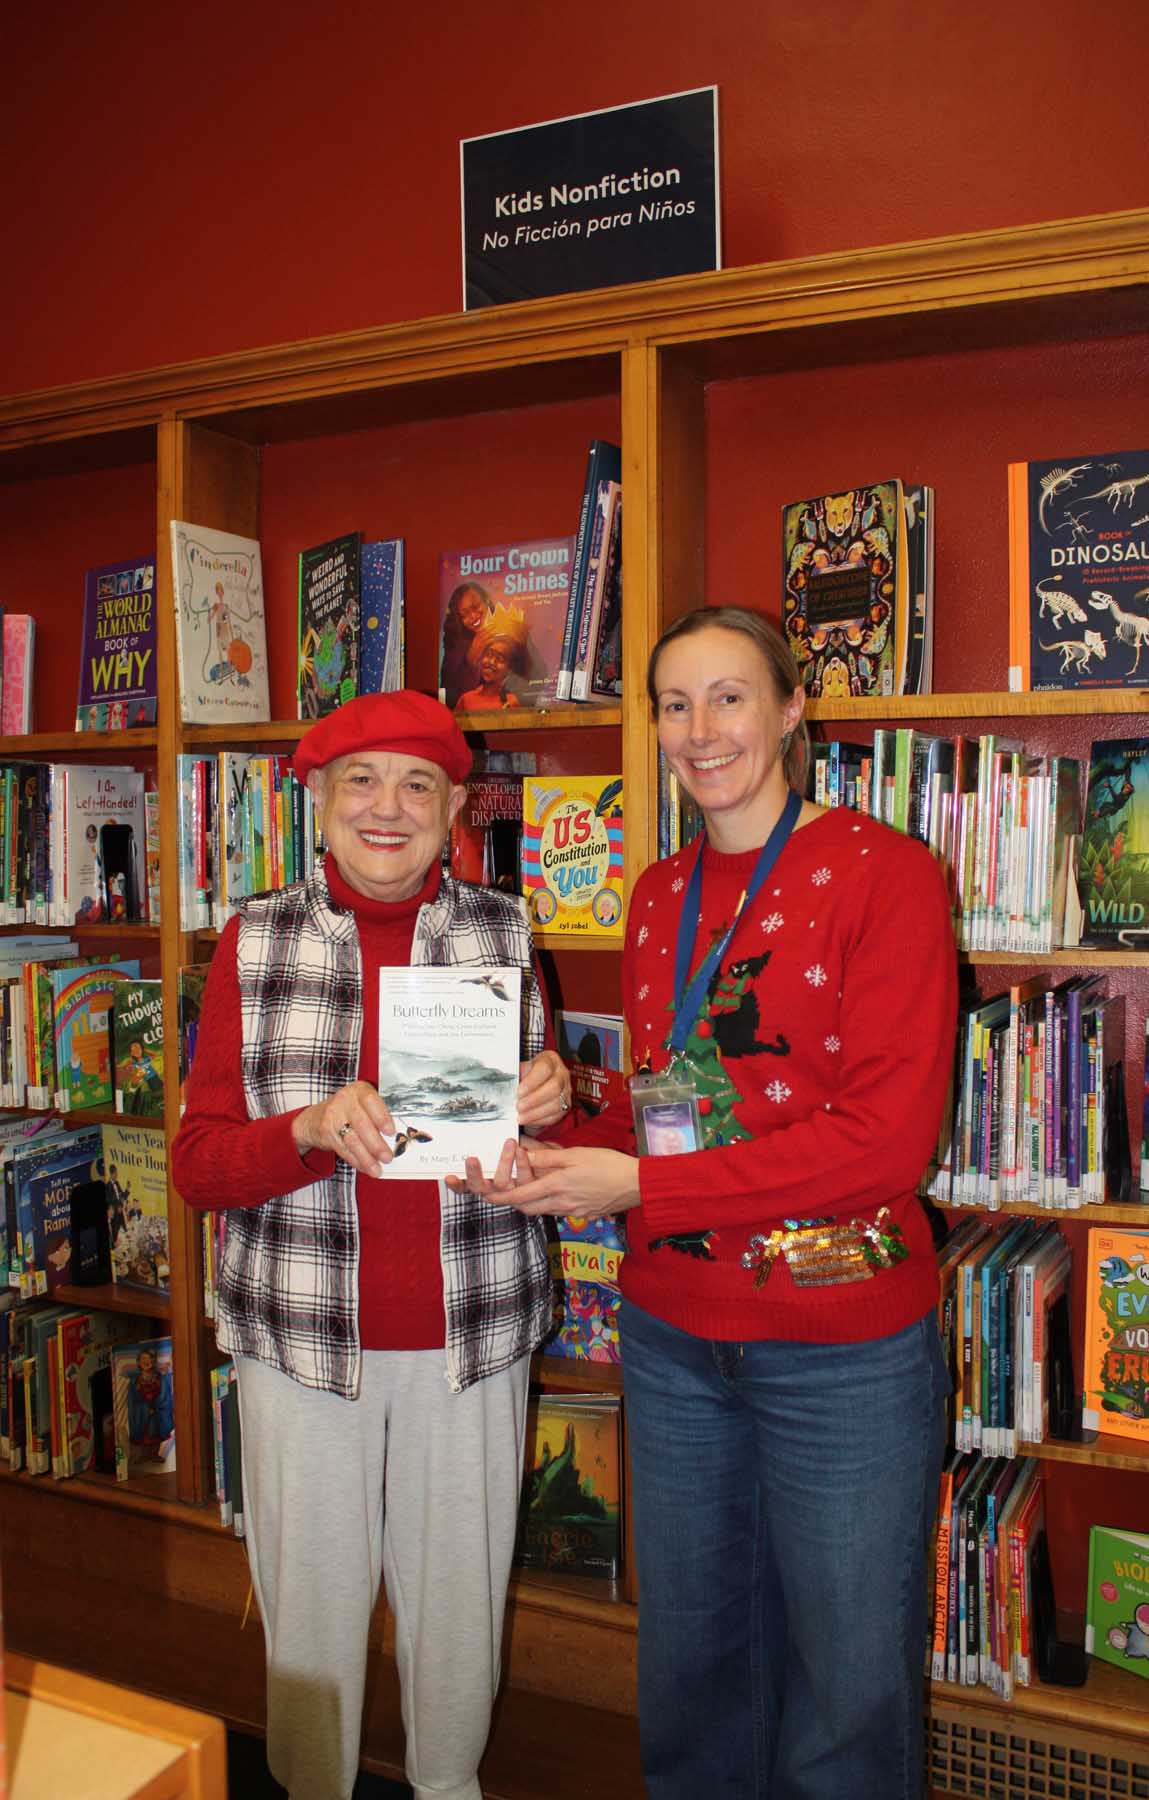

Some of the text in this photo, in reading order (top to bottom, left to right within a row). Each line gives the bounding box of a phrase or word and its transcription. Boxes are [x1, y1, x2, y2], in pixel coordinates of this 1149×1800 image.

[495, 167, 680, 217] Kids Nonfiction
[483, 200, 695, 250] No Ficción para Niños
[189, 548, 247, 576] Cinderella
[460, 547, 569, 576] Your Crown
[1050, 541, 1149, 567] DINOSAU
[311, 558, 333, 583] WEIRD
[334, 553, 345, 569] AND
[308, 564, 348, 601] WONDERFUL
[504, 572, 568, 595] Shines
[104, 593, 152, 619] WORLD
[323, 594, 343, 615] PLANET
[95, 612, 152, 639] ALMANAC
[104, 636, 139, 652] BOOK OF
[91, 649, 153, 693] WHY
[76, 795, 137, 809] Left-Handed!
[566, 804, 579, 815] The
[553, 809, 595, 849] U.S.
[543, 842, 607, 869] Constitution
[580, 859, 591, 867] and
[553, 865, 598, 898] You
[1088, 899, 1145, 924] WILD
[127, 989, 144, 1008] MY
[392, 1003, 506, 1019] Butterfly Dreams
[576, 1078, 602, 1099] MAIL
[117, 1129, 141, 1145] Next
[109, 1147, 143, 1165] White
[935, 1593, 947, 1642] ARCTIC
